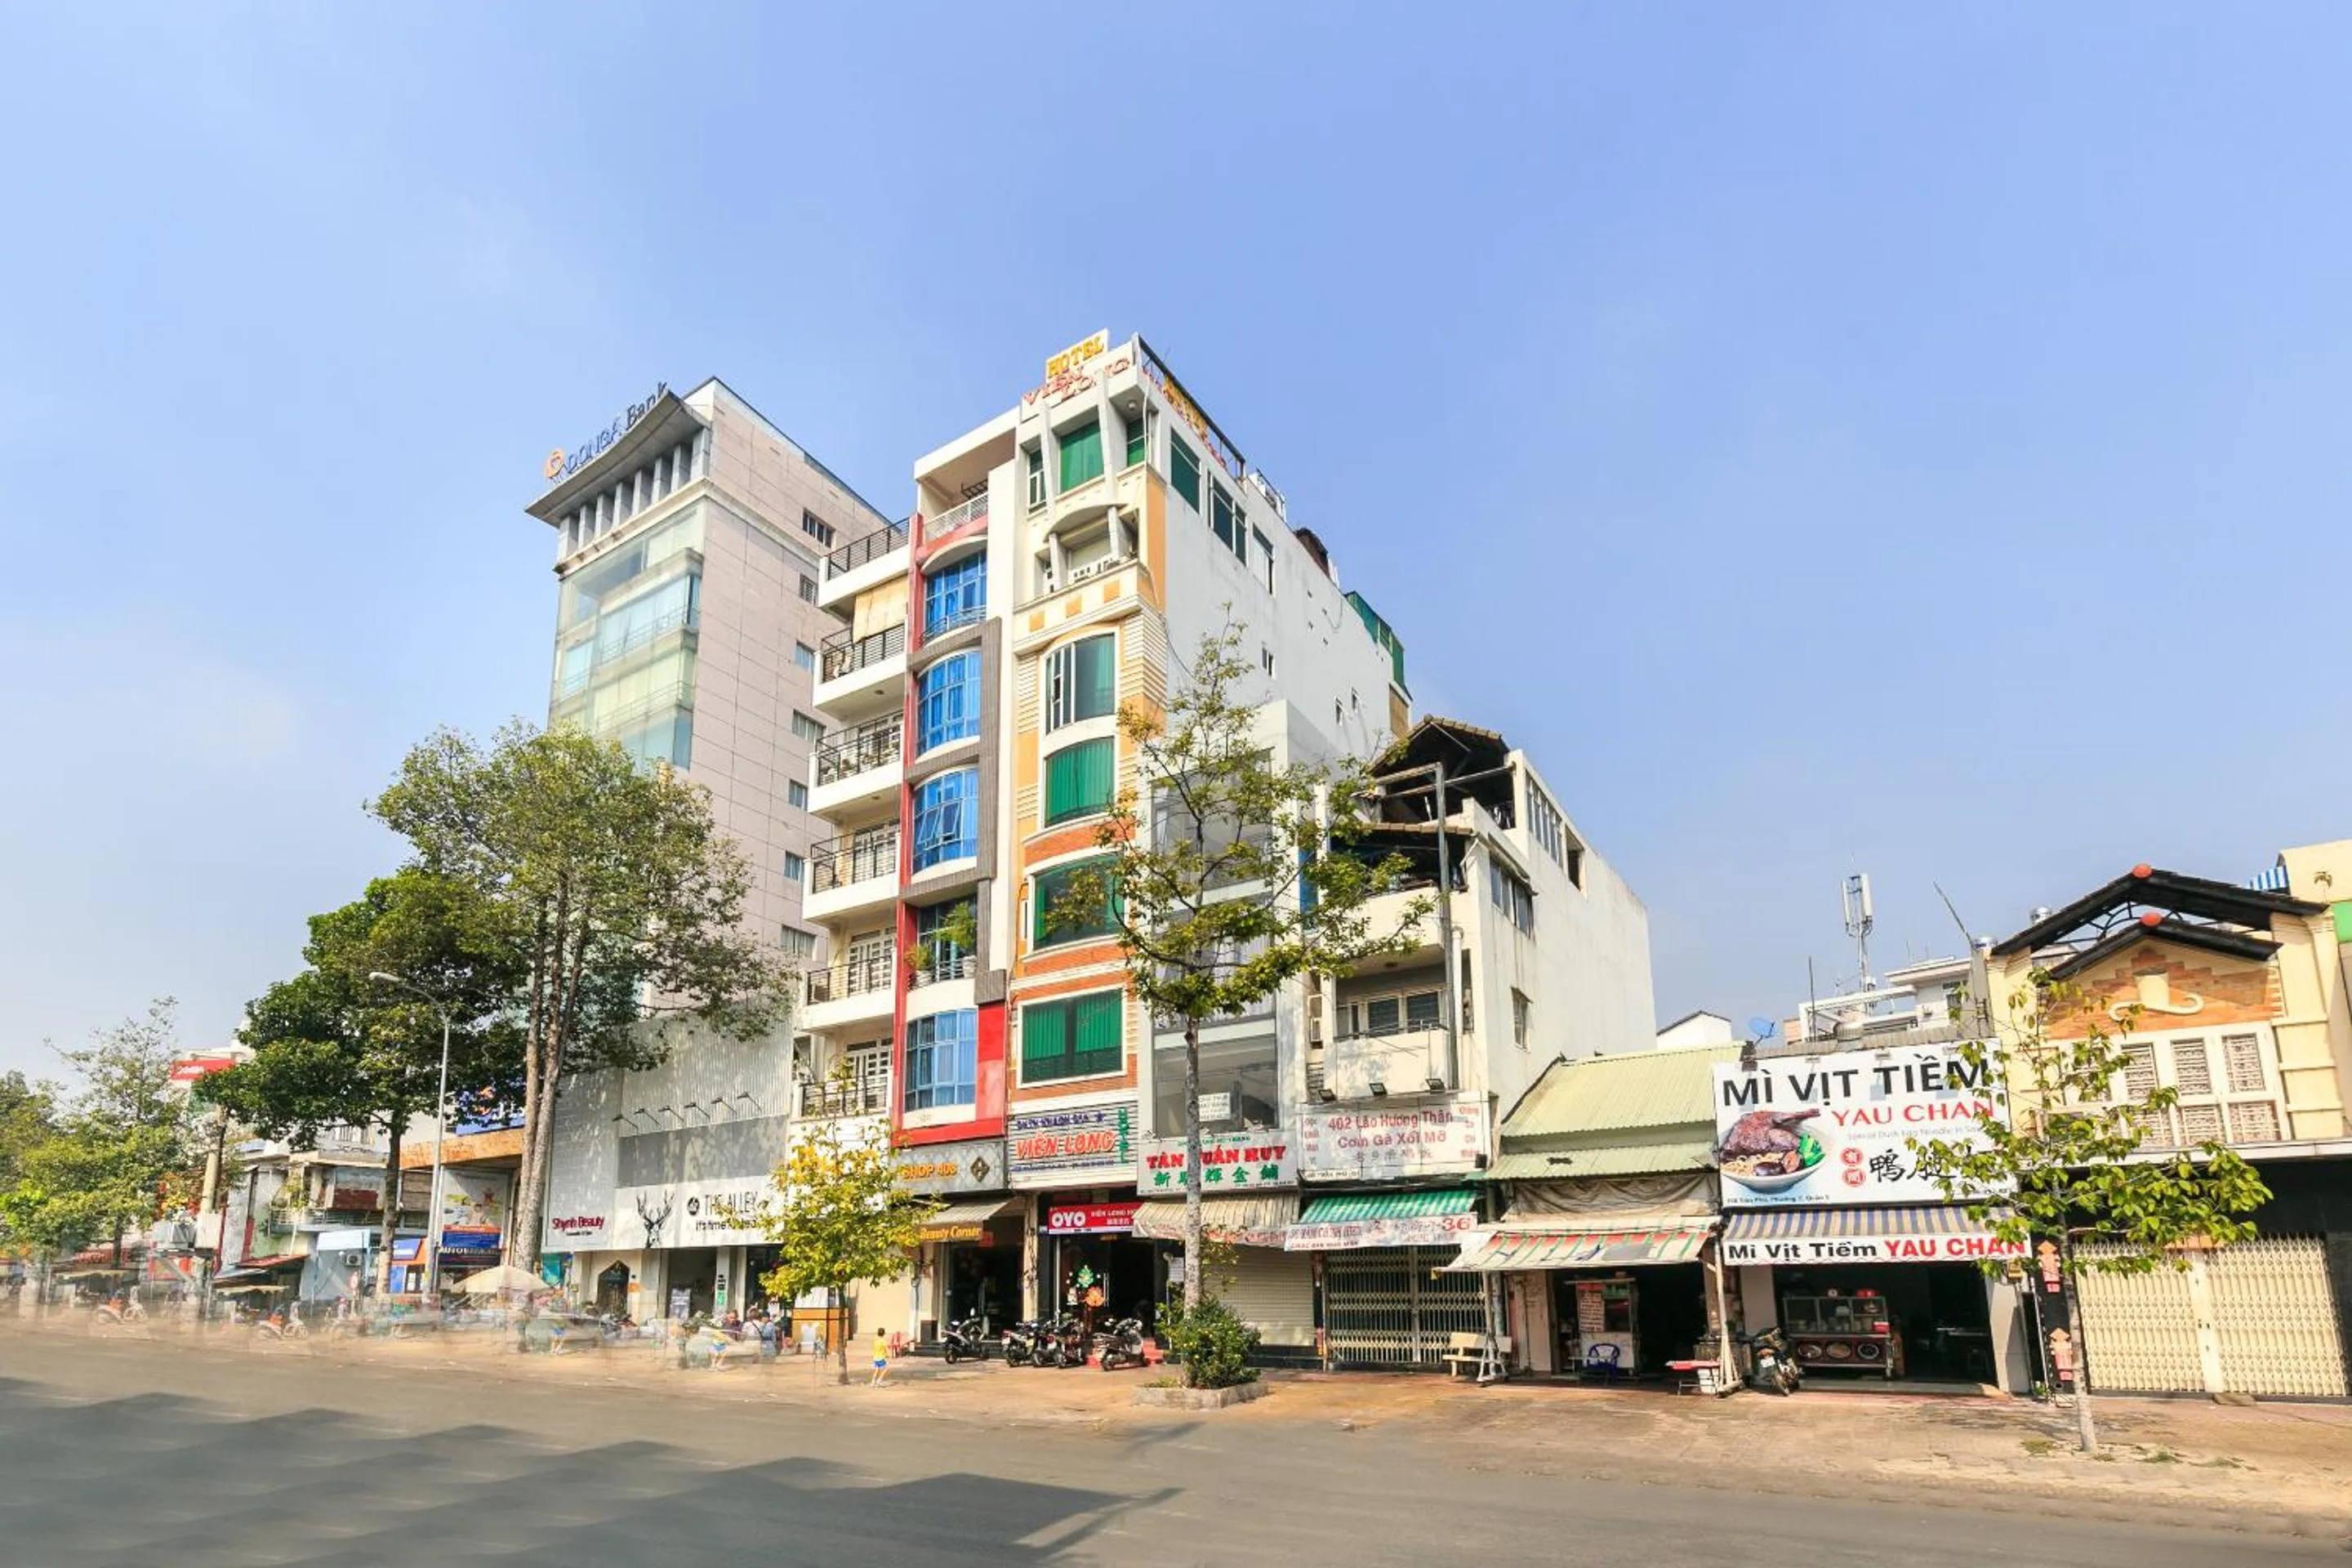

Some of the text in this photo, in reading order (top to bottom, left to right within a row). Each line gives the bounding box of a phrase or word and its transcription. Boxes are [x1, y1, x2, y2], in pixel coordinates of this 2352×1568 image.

[1048, 336, 1104, 378] HOTEL
[626, 381, 667, 430] Bank
[1723, 1052, 1990, 1107] MÌ VỊT TIỀM
[1422, 1110, 1454, 1124] Thân
[1832, 1094, 1994, 1127] YAU CHAN
[1063, 1129, 1117, 1154] LONG
[1244, 1145, 1287, 1163] HUY
[901, 1165, 934, 1180] SHOP
[578, 1216, 604, 1229] Beauty
[1051, 1211, 1085, 1227] OYO
[919, 1227, 950, 1240] Beauty
[951, 1225, 982, 1239] Corner
[1766, 1243, 1800, 1261] Vịt
[1885, 1240, 1936, 1257] YAU
[1947, 1237, 2025, 1255] CHAN
